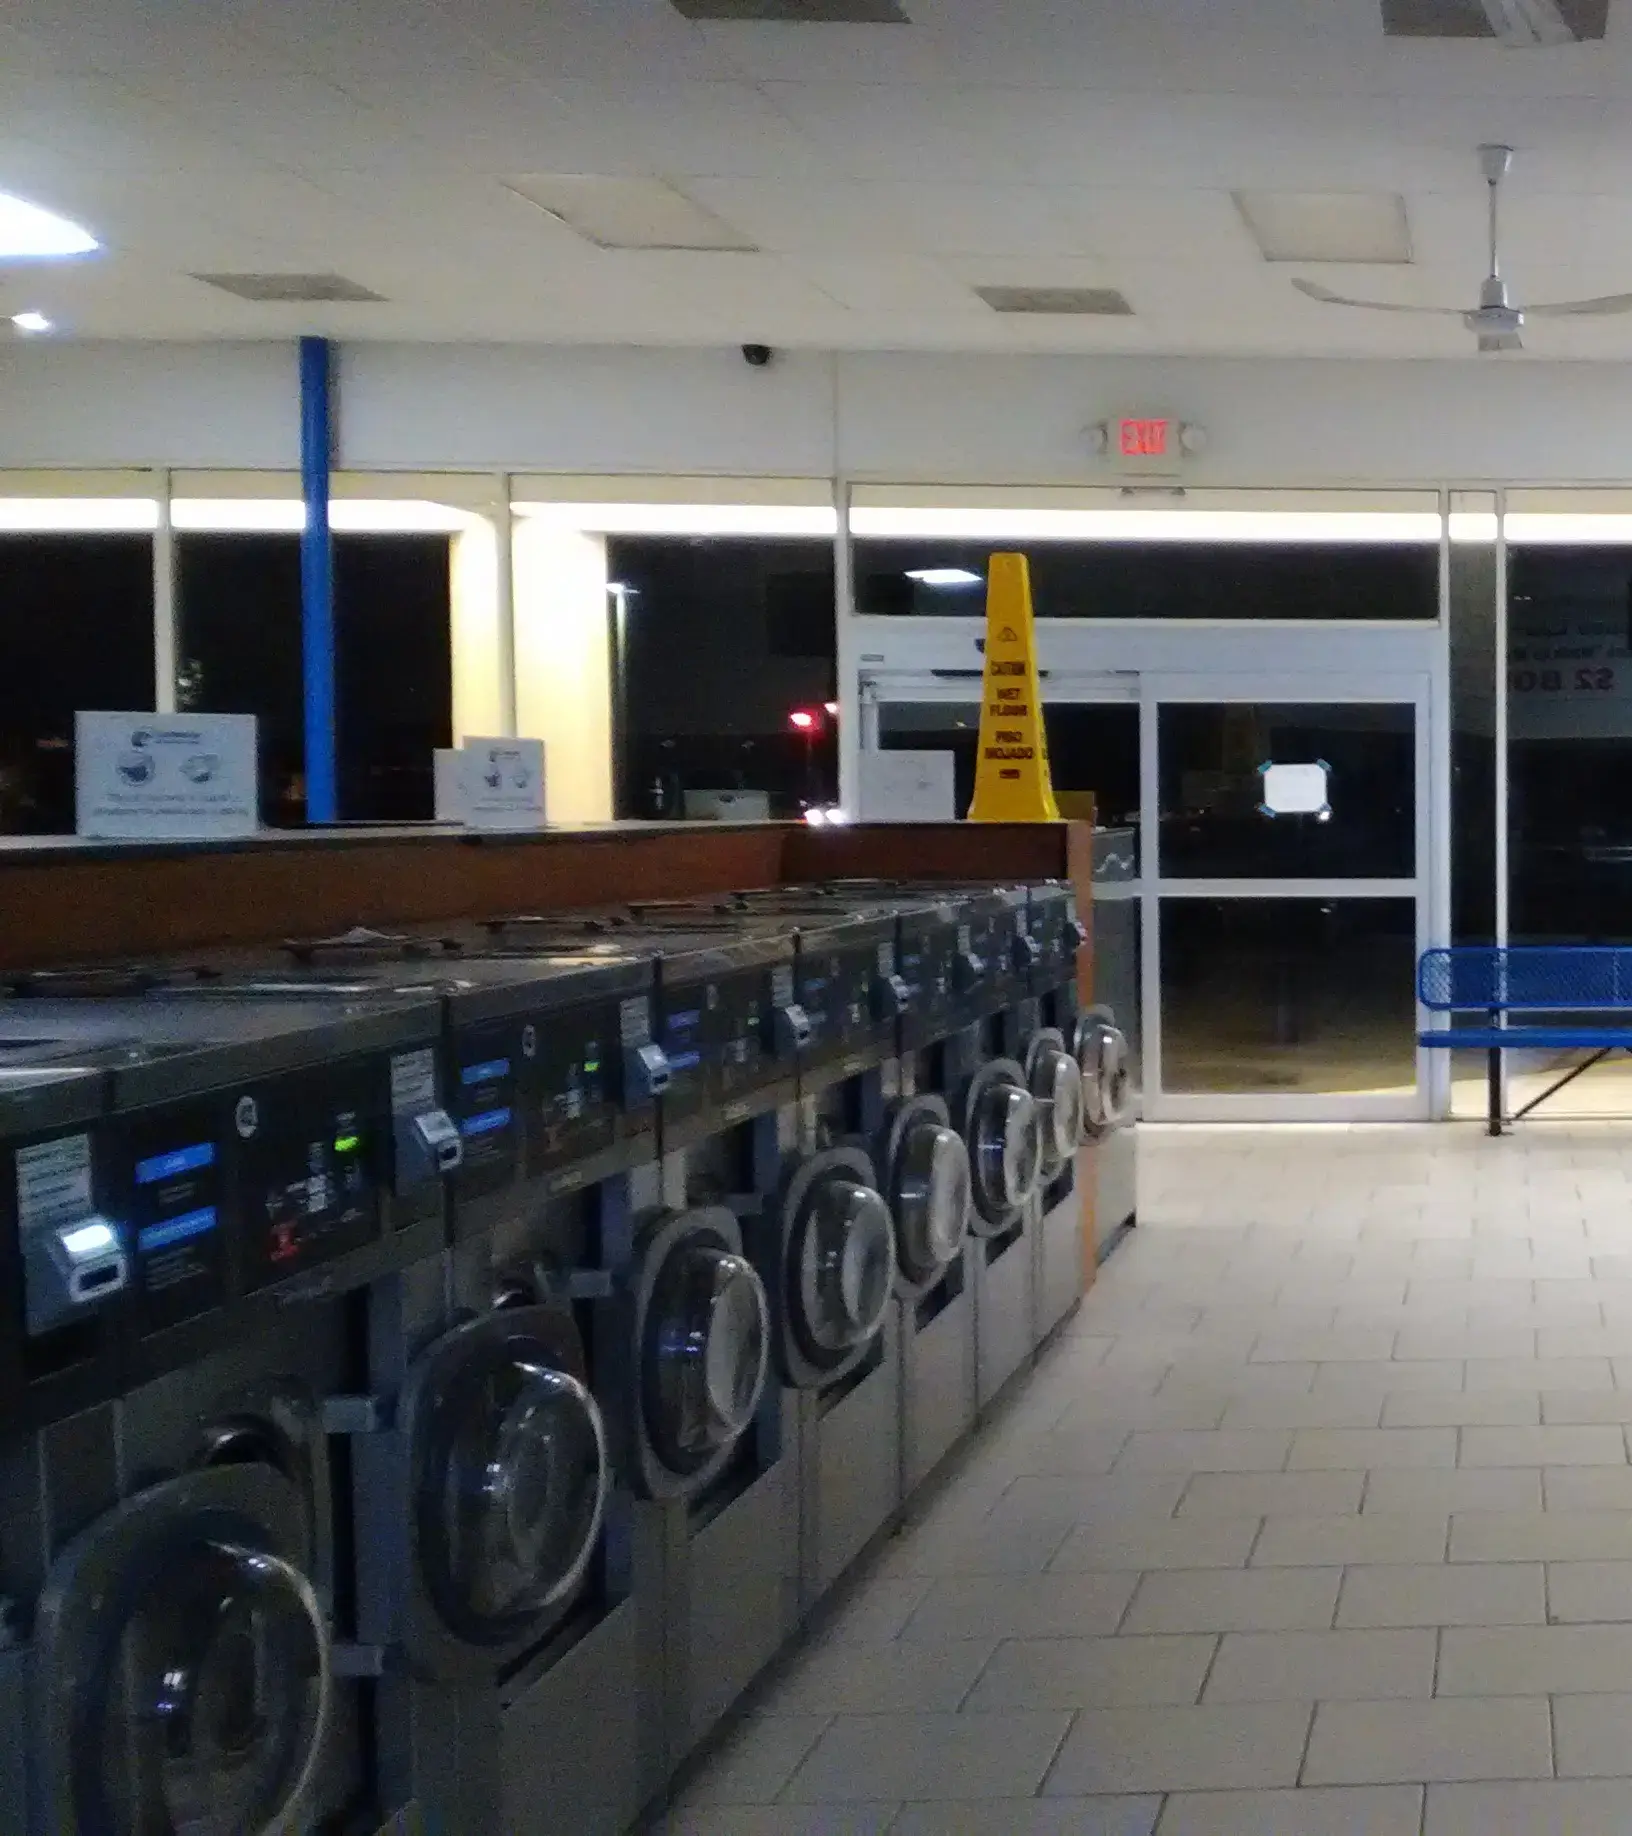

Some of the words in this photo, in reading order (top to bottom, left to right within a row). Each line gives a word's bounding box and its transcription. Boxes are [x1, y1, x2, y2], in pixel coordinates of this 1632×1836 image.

[1120, 418, 1168, 456] EXIT
[996, 687, 1021, 700] WET
[995, 730, 1023, 743] PISO
